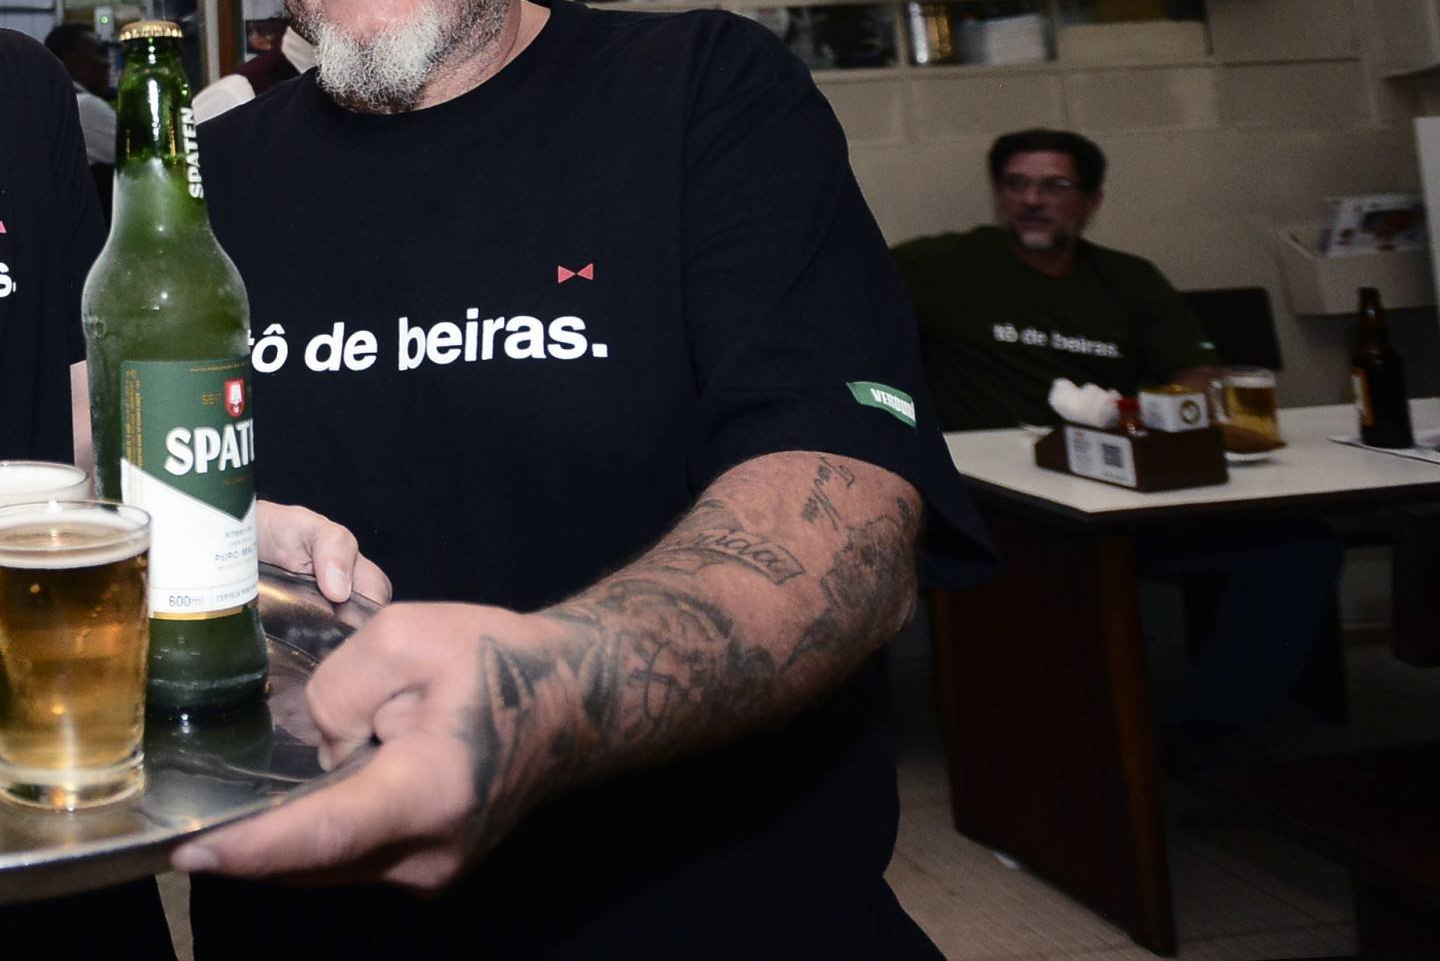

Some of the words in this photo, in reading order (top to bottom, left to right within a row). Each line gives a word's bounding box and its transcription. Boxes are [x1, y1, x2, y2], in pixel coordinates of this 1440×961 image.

[180, 106, 204, 199] SPATEN
[304, 322, 378, 372] de
[398, 307, 608, 371] beiras.
[1020, 327, 1047, 346] de
